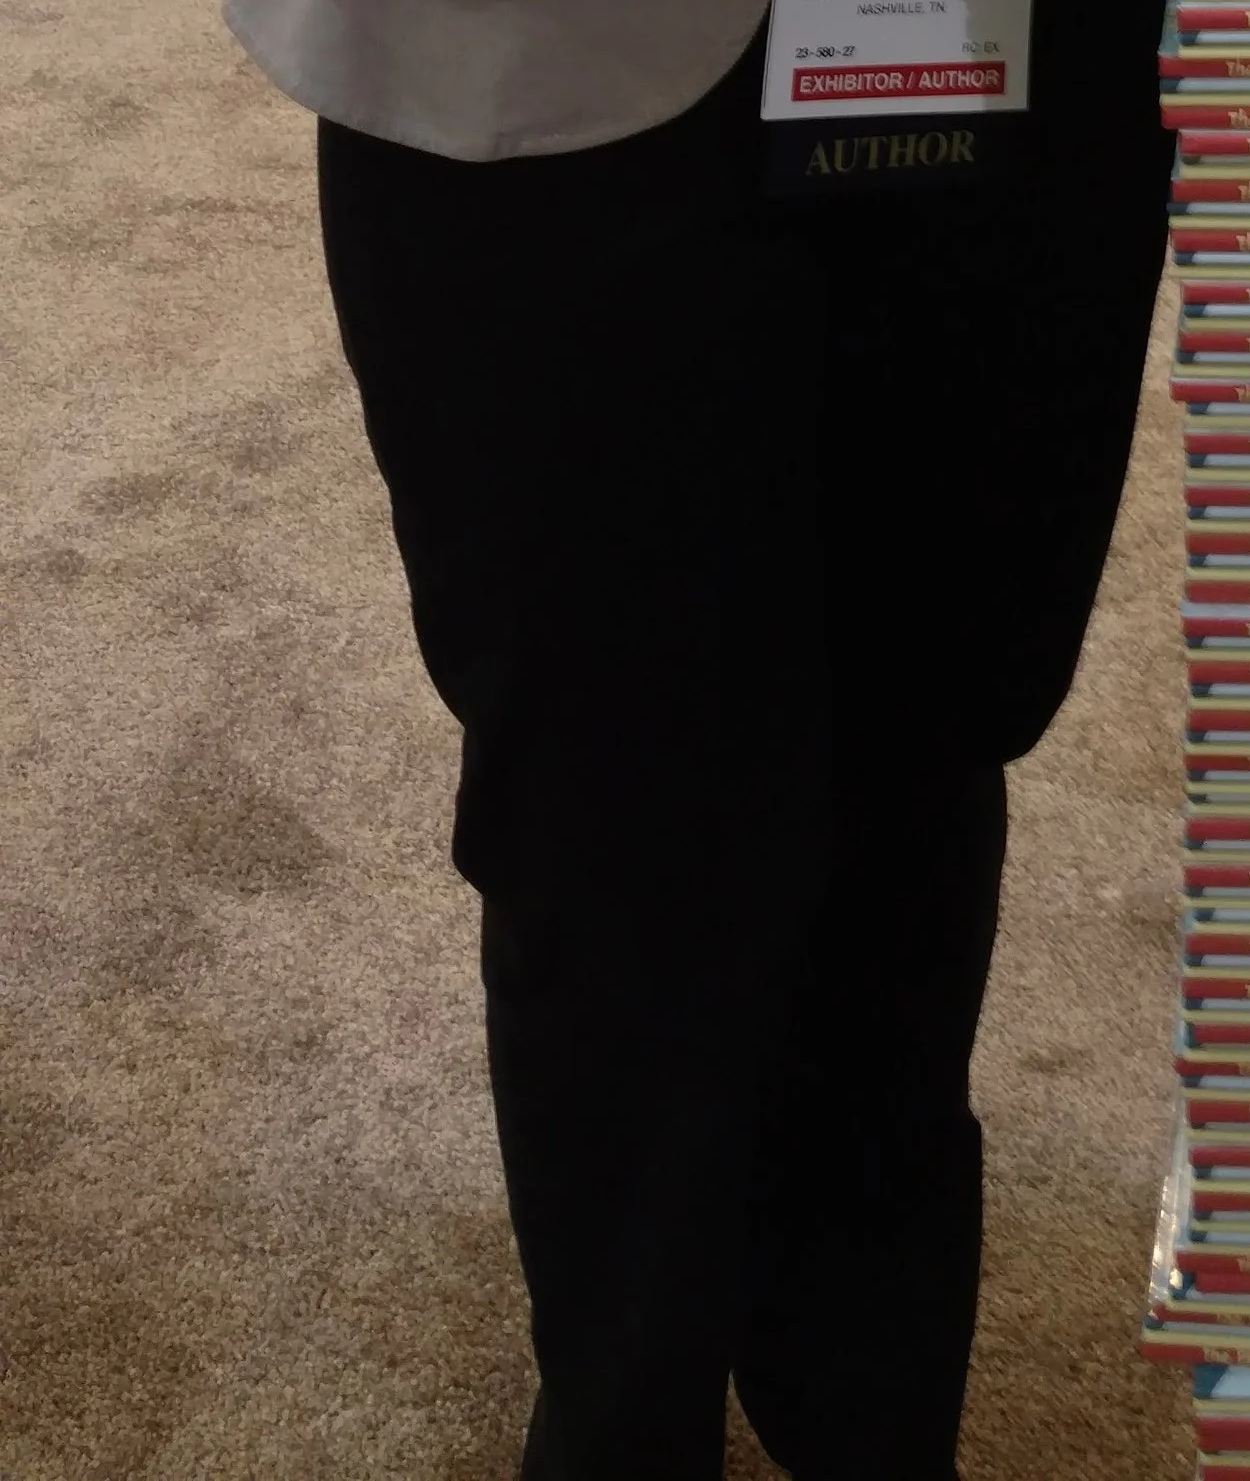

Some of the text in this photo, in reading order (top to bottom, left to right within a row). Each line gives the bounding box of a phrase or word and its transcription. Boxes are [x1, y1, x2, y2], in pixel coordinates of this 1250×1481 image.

[799, 71, 905, 95] EXHIBITOR
[917, 68, 1001, 91] AUTHOR
[804, 128, 977, 177] AUTHOR
